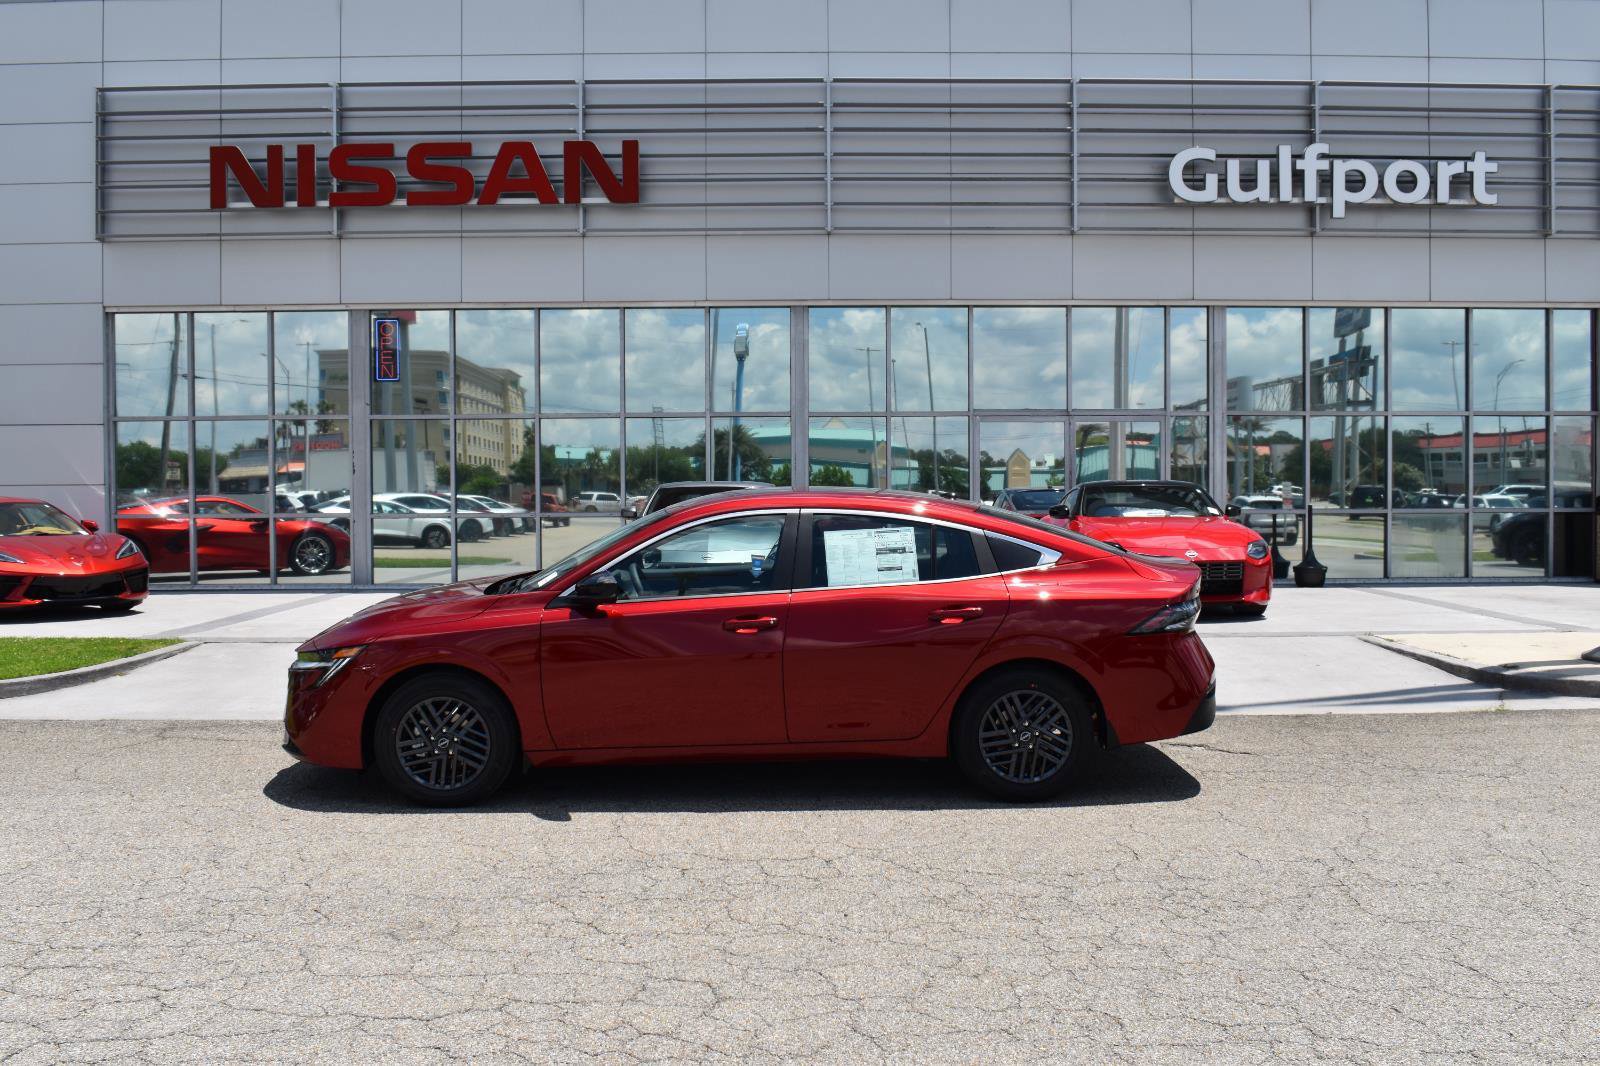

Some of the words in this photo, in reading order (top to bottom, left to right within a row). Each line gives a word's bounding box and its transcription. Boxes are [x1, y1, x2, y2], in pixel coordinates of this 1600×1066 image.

[210, 140, 638, 208] NISSAN
[1168, 142, 1498, 218] Gulfport
[381, 322, 394, 378] OPEN
